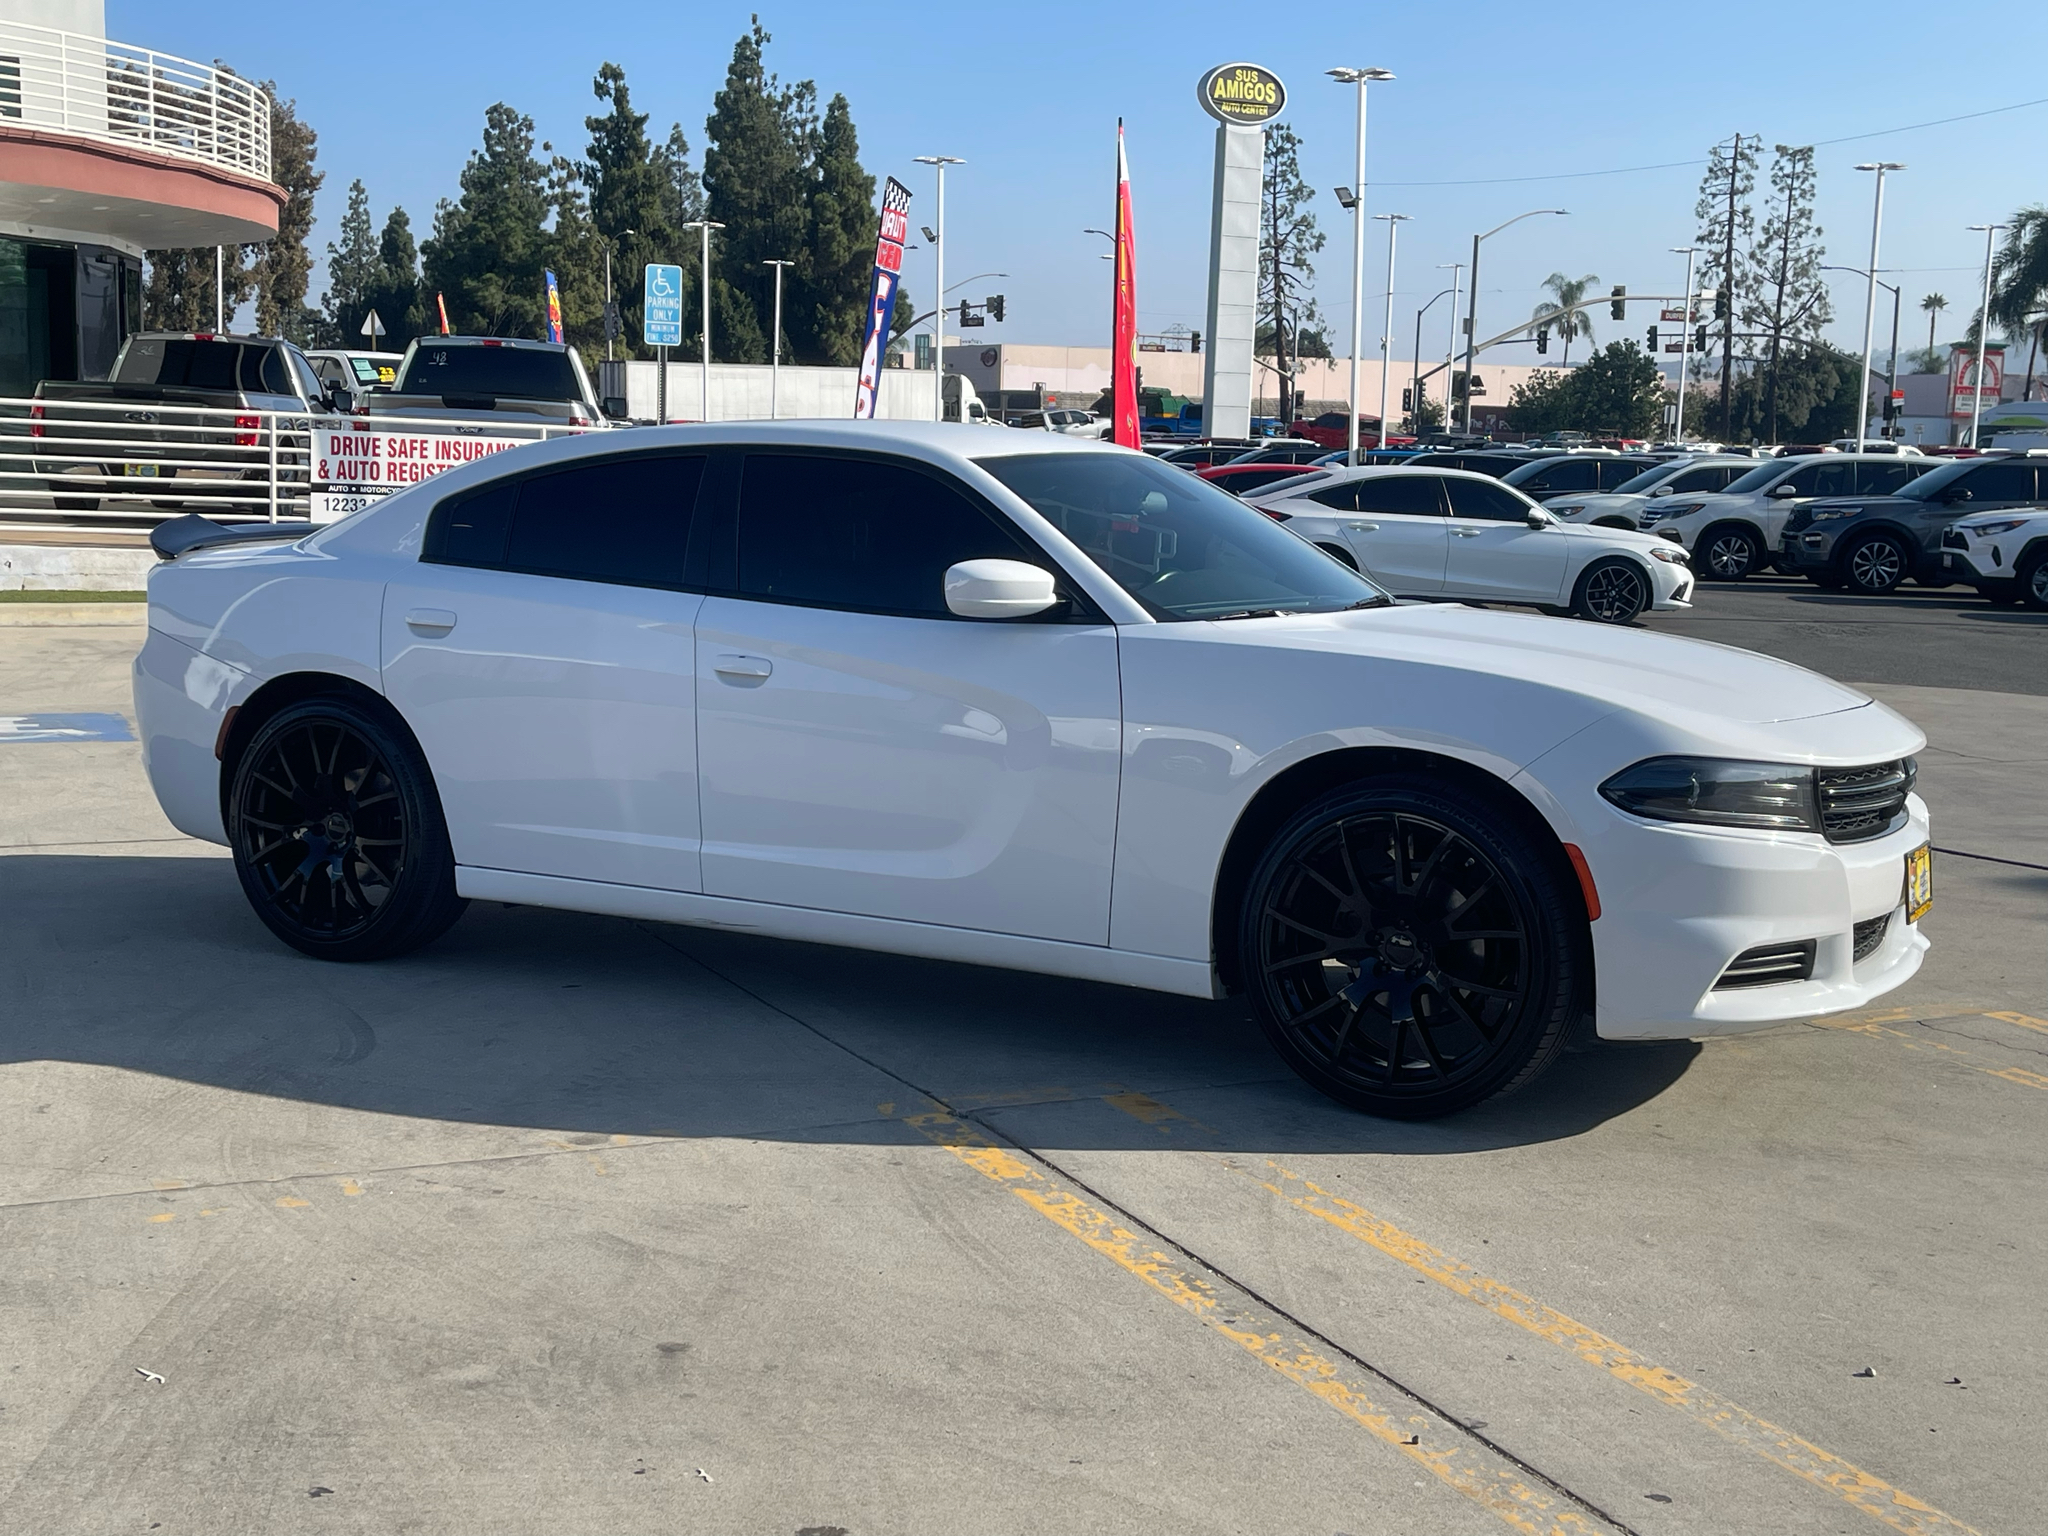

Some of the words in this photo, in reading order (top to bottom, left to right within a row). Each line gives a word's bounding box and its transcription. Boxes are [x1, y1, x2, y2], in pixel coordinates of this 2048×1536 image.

[1235, 69, 1259, 83] SUS
[1213, 77, 1276, 104] AMIGOS
[1221, 102, 1241, 113] AUTO
[1241, 103, 1269, 116] CENTER
[647, 296, 679, 309] PARKING
[653, 309, 673, 321] ONLY
[650, 324, 675, 333] MINIMUM
[662, 333, 679, 342] $250
[432, 351, 447, 363] 48
[379, 366, 395, 375] 22
[1957, 388, 1999, 396] CARERIA
[330, 436, 381, 457] DRIVE
[387, 438, 428, 459] SAFE
[435, 440, 518, 461] INSURA
[318, 459, 331, 480] &
[336, 459, 381, 481] AUTO
[324, 497, 366, 512] 12233
